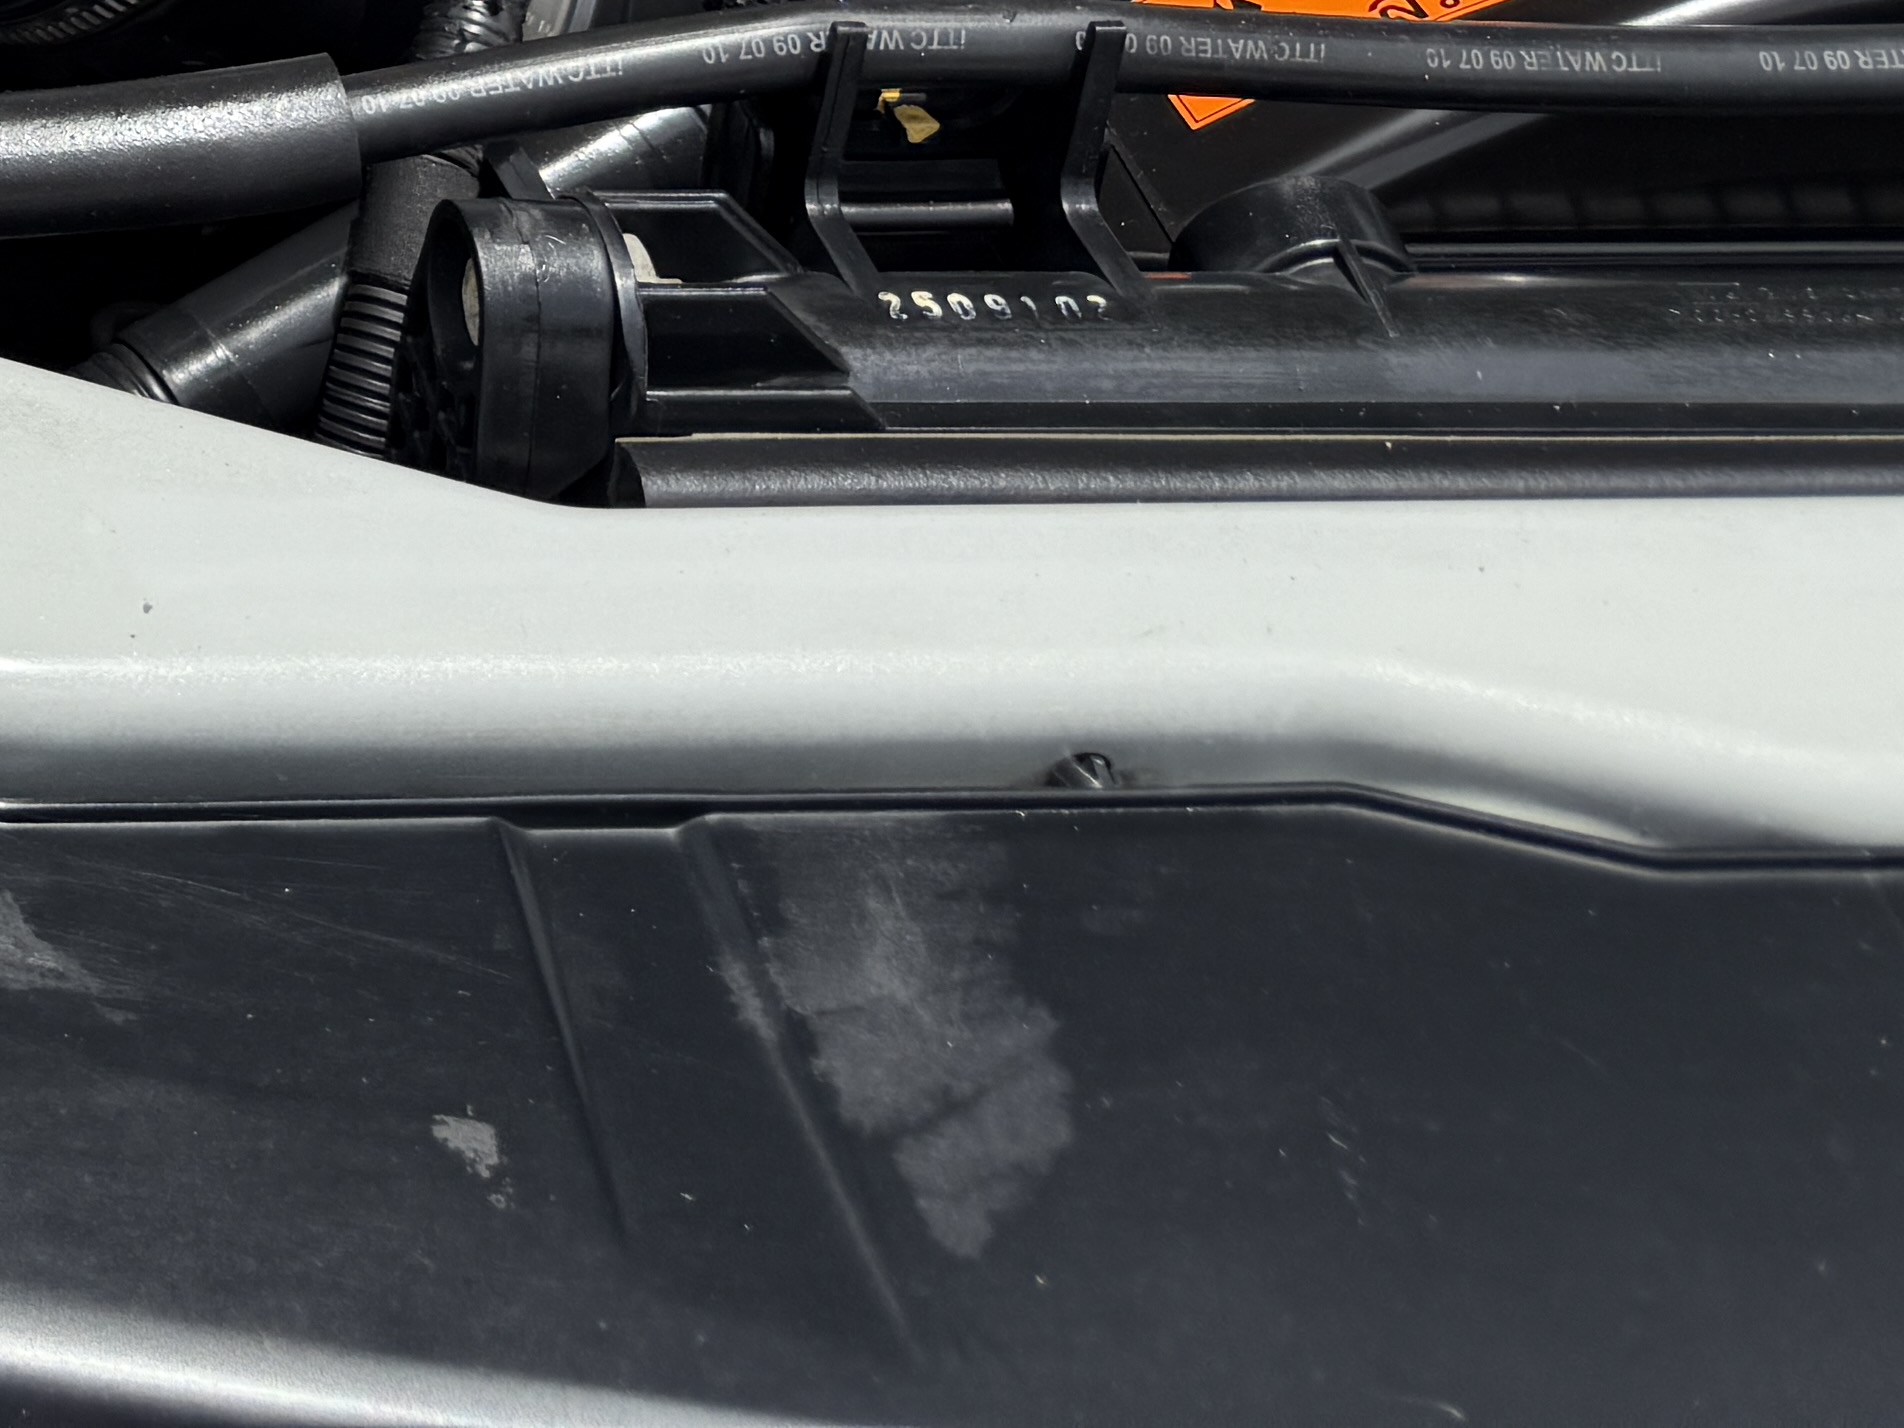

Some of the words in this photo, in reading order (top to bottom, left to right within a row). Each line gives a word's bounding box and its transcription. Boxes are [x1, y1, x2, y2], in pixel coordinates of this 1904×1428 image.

[703, 42, 727, 64] 10
[738, 38, 764, 60] 07
[773, 33, 800, 54] 09
[1146, 33, 1173, 56] 09
[1178, 34, 1268, 62] WATER
[1425, 47, 1451, 69] 10
[1458, 48, 1485, 70] 07
[1489, 48, 1517, 70] 09
[1519, 47, 1608, 72] WATER
[1758, 49, 1786, 72] 10
[1792, 49, 1819, 72] 07
[1822, 49, 1851, 72] 09
[470, 69, 563, 97] WATER
